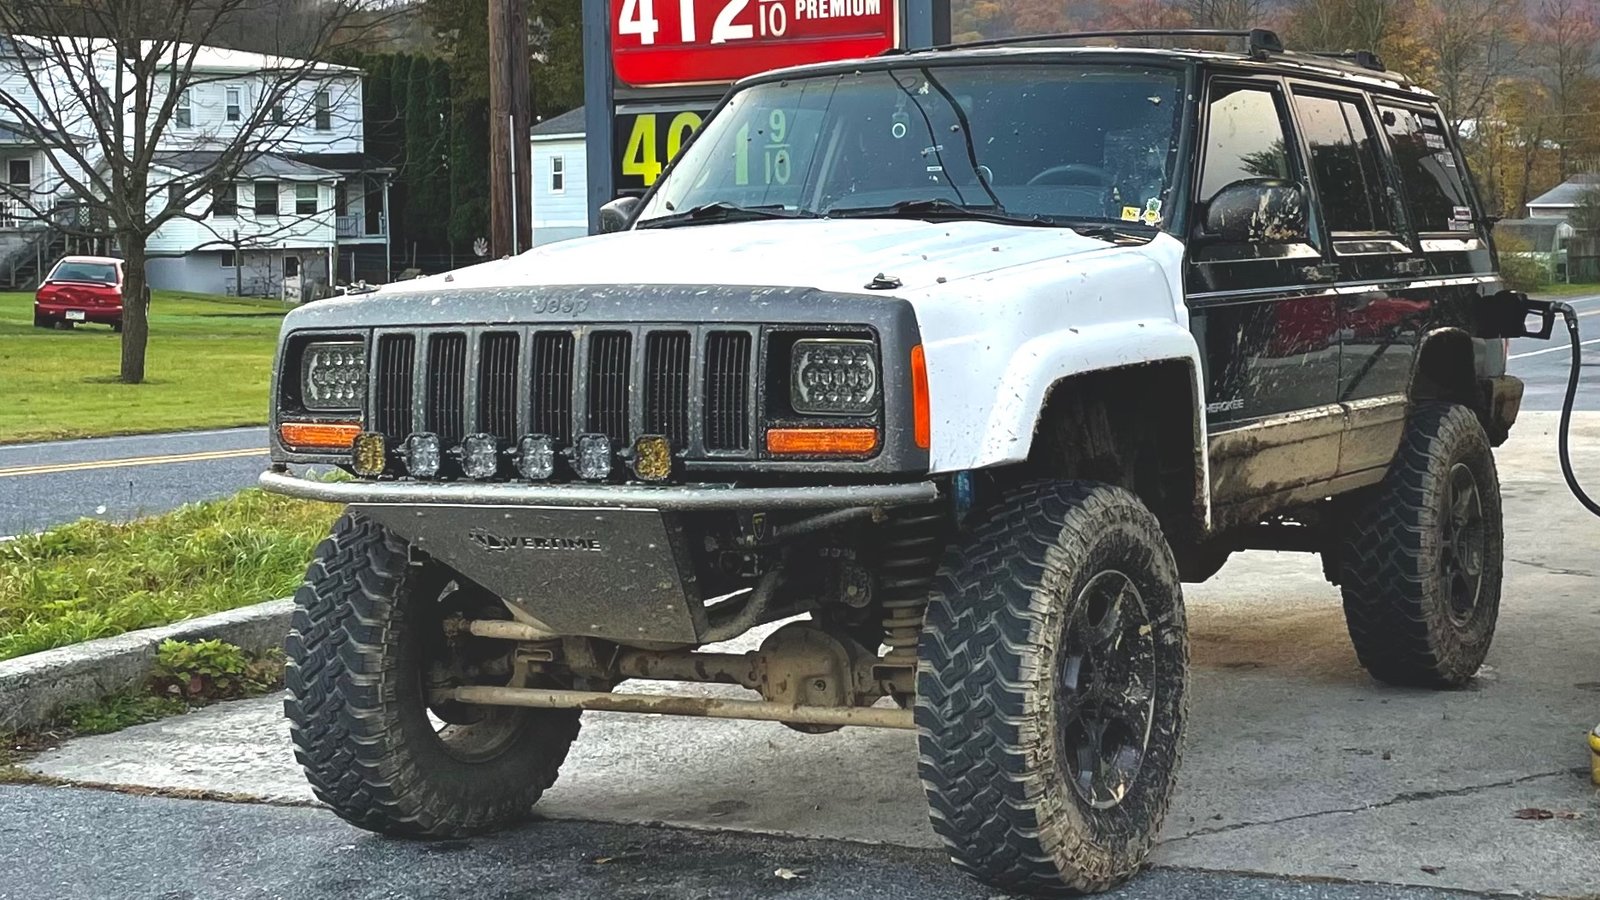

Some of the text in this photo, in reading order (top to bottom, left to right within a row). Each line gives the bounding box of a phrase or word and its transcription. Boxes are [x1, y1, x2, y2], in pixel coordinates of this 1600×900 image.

[759, 2, 788, 37] 10
[795, 0, 882, 20] PREMIUM
[531, 295, 590, 318] Jeep
